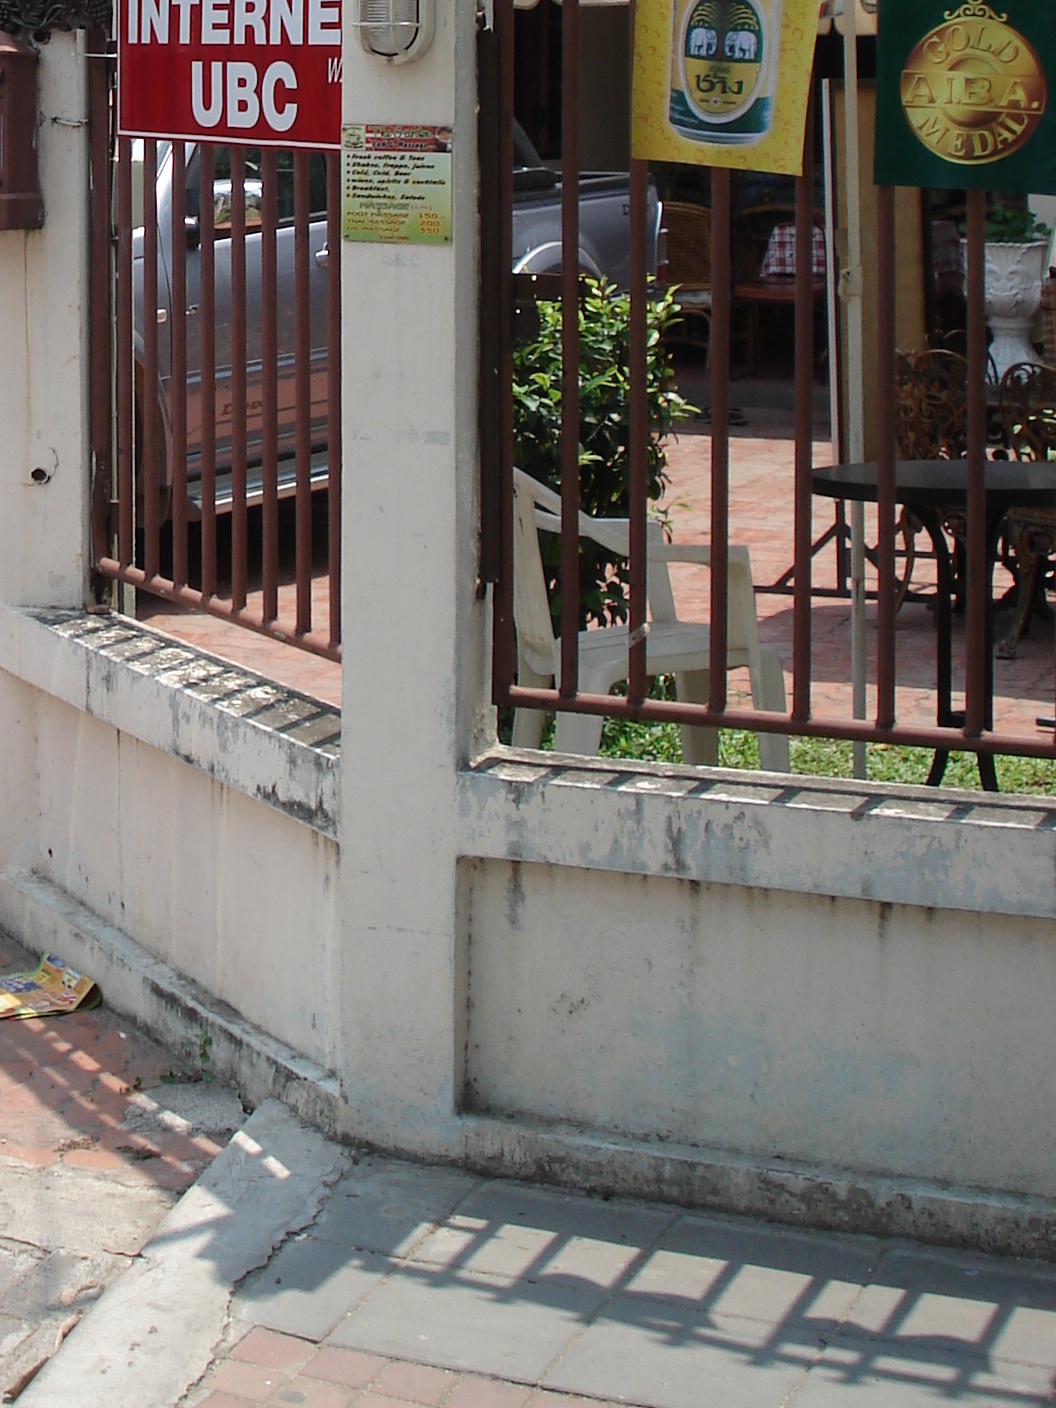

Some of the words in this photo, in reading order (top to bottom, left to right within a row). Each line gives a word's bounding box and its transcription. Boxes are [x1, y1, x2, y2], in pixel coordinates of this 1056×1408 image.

[924, 25, 1019, 64] GOLD
[190, 59, 299, 133] UBC
[694, 72, 744, 95] ช้าง
[917, 112, 1029, 157] MEDAL
